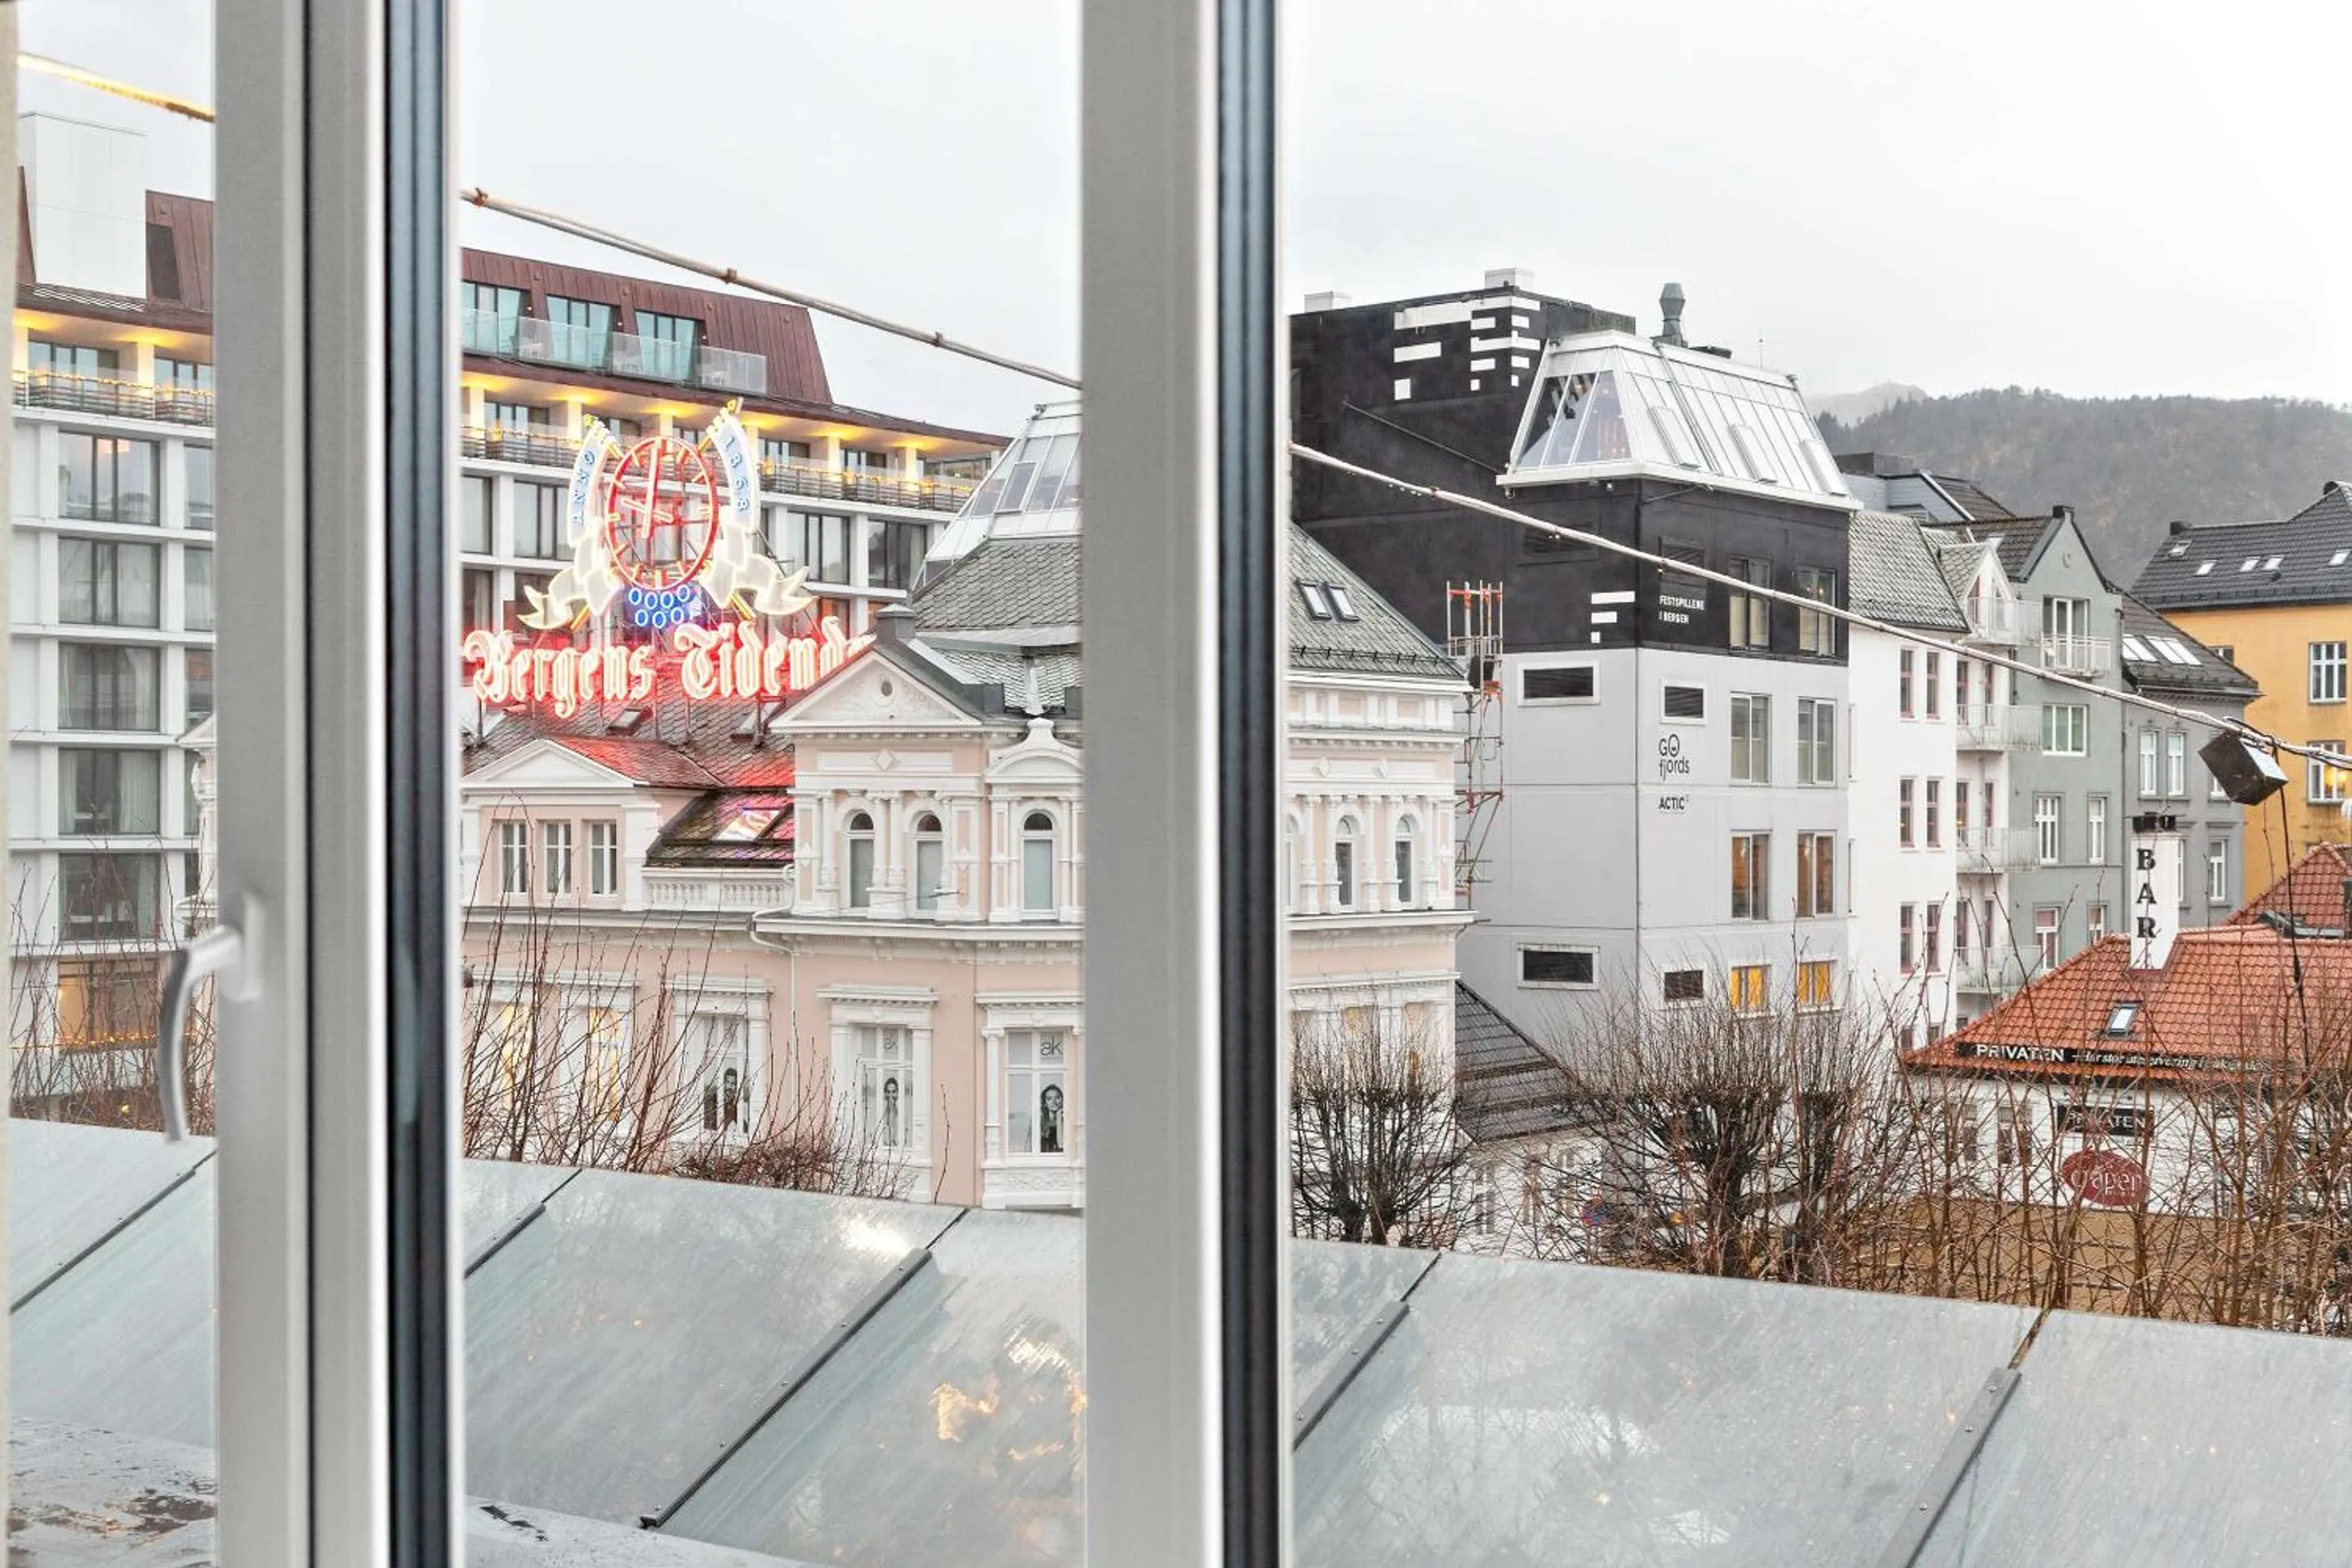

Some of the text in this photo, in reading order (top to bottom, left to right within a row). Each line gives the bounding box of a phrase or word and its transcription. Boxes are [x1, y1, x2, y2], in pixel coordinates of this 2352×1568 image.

[572, 435, 751, 526] ANNO 1868
[1659, 595, 1705, 611] FESTSPILLENE
[1664, 611, 1690, 624] BERGEN
[464, 630, 657, 719] Bergens
[1659, 733, 1680, 757] GO
[1659, 755, 1690, 781] fjords
[1659, 797, 1685, 810] ACTIC
[2136, 848, 2158, 938] BAR
